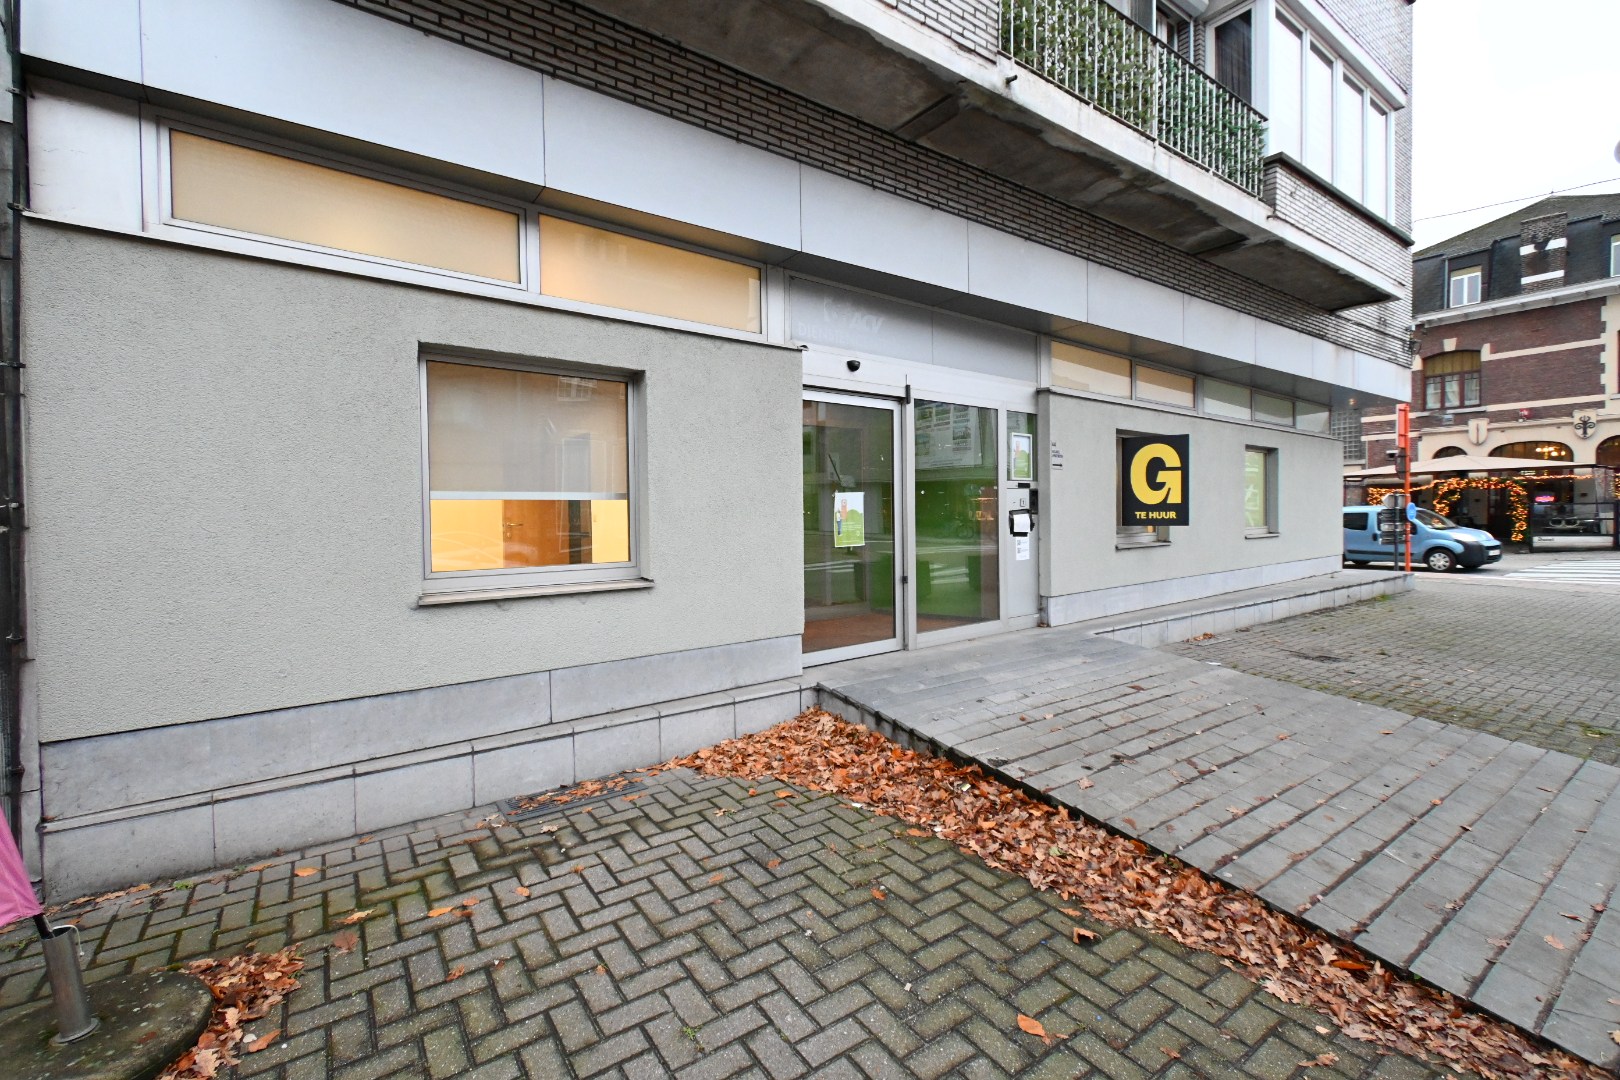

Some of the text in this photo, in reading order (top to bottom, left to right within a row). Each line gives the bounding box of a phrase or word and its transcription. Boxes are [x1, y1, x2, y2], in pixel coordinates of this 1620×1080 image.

[1130, 443, 1181, 504] G
[1135, 511, 1176, 519] TE HUUR
